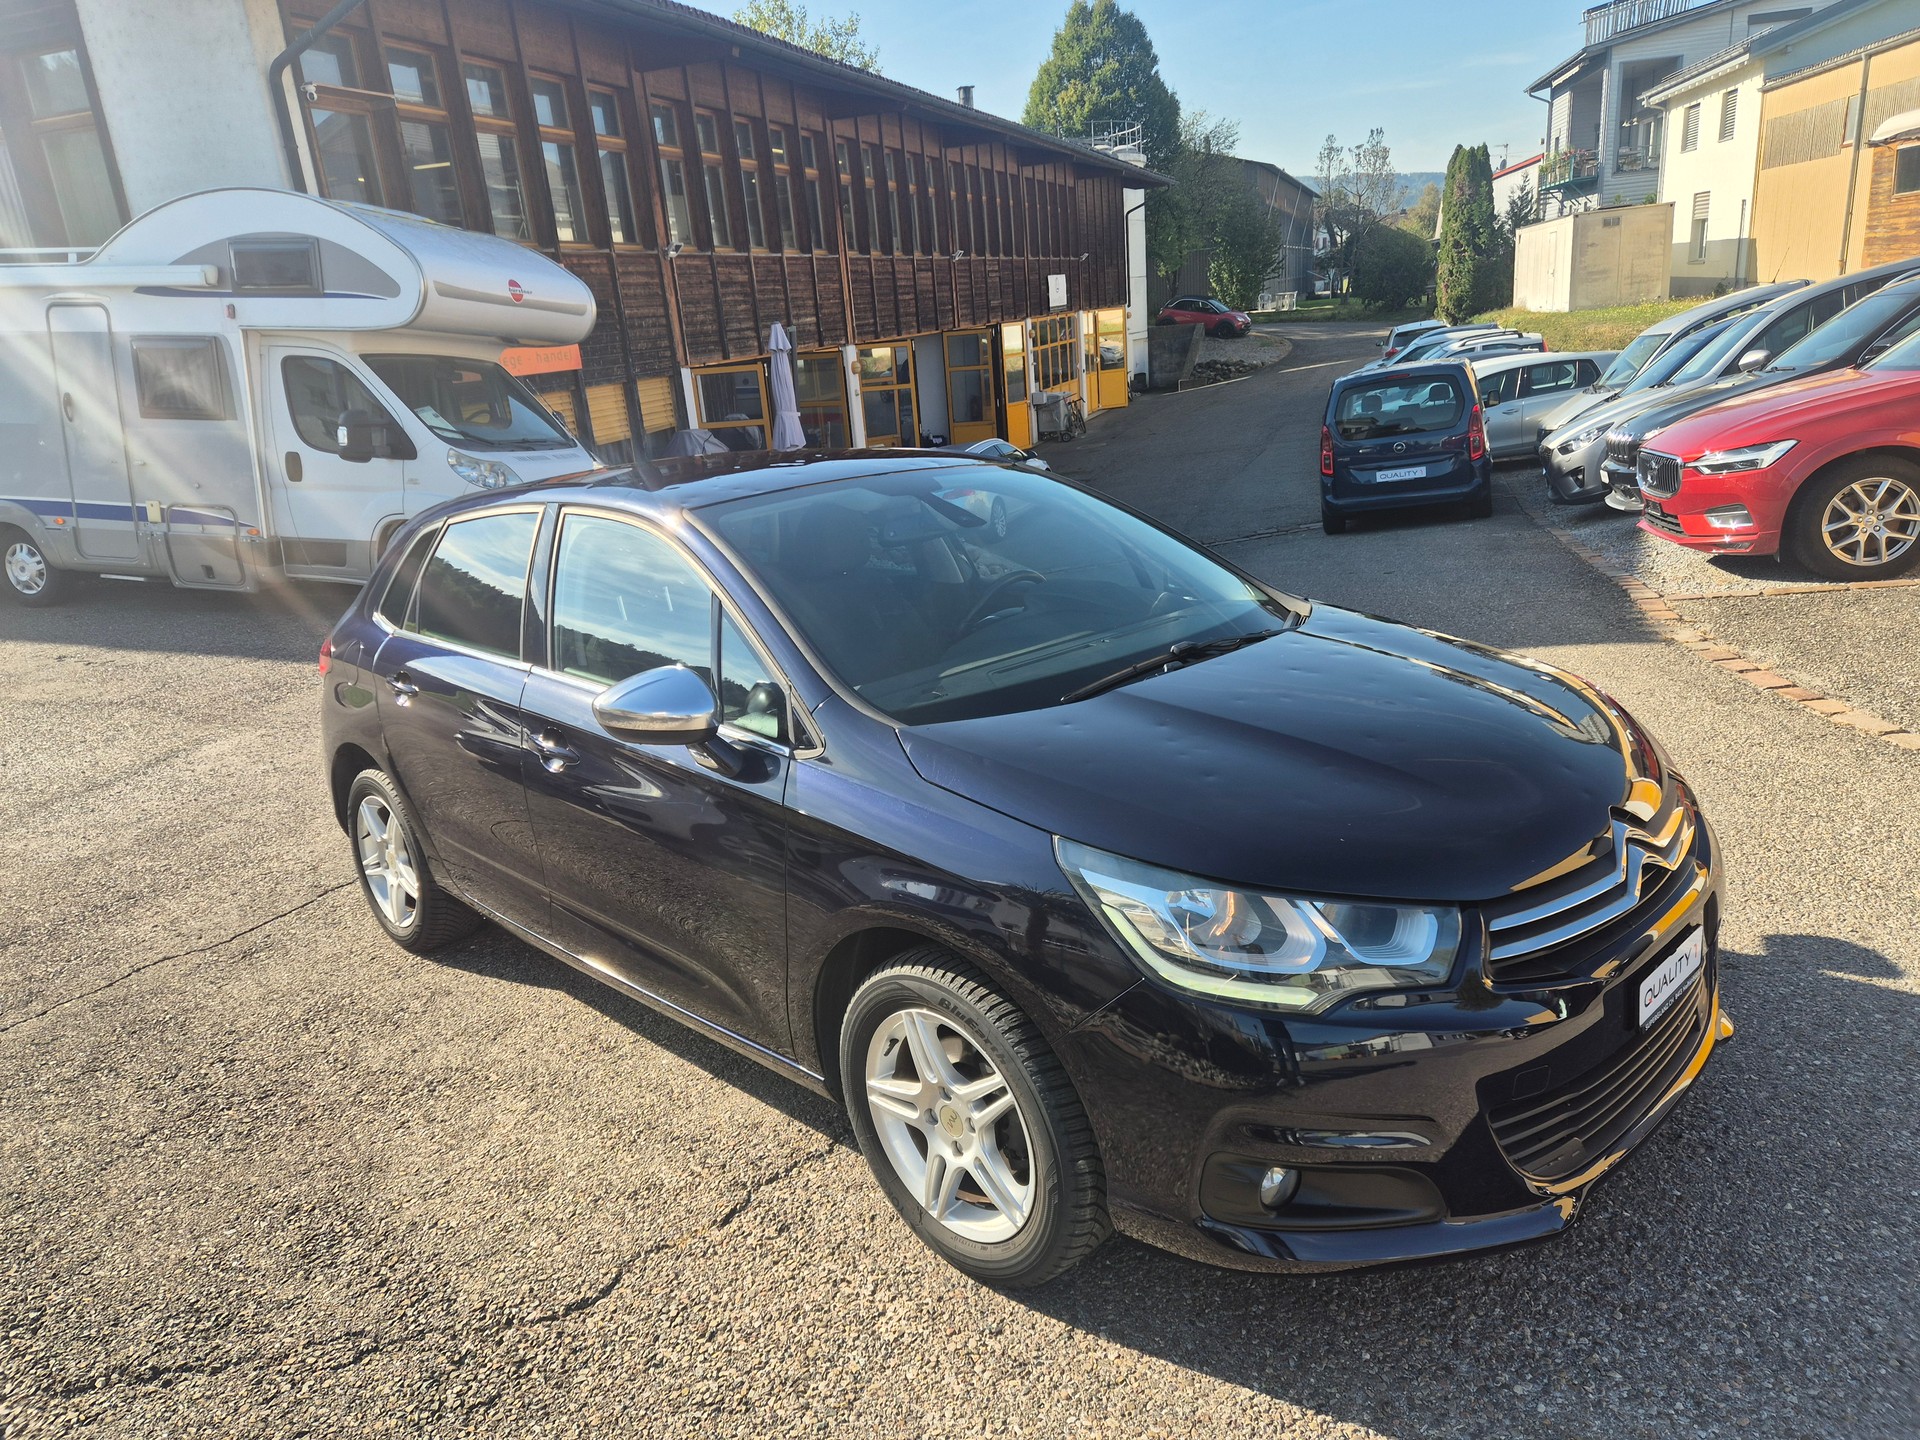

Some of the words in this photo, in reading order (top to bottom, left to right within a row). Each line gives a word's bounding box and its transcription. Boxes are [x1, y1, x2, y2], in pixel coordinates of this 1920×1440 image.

[502, 355, 524, 369] ege
[1379, 470, 1418, 480] QUALITY
[1644, 947, 1692, 1008] QUALITY
[1693, 943, 1699, 959] 1
